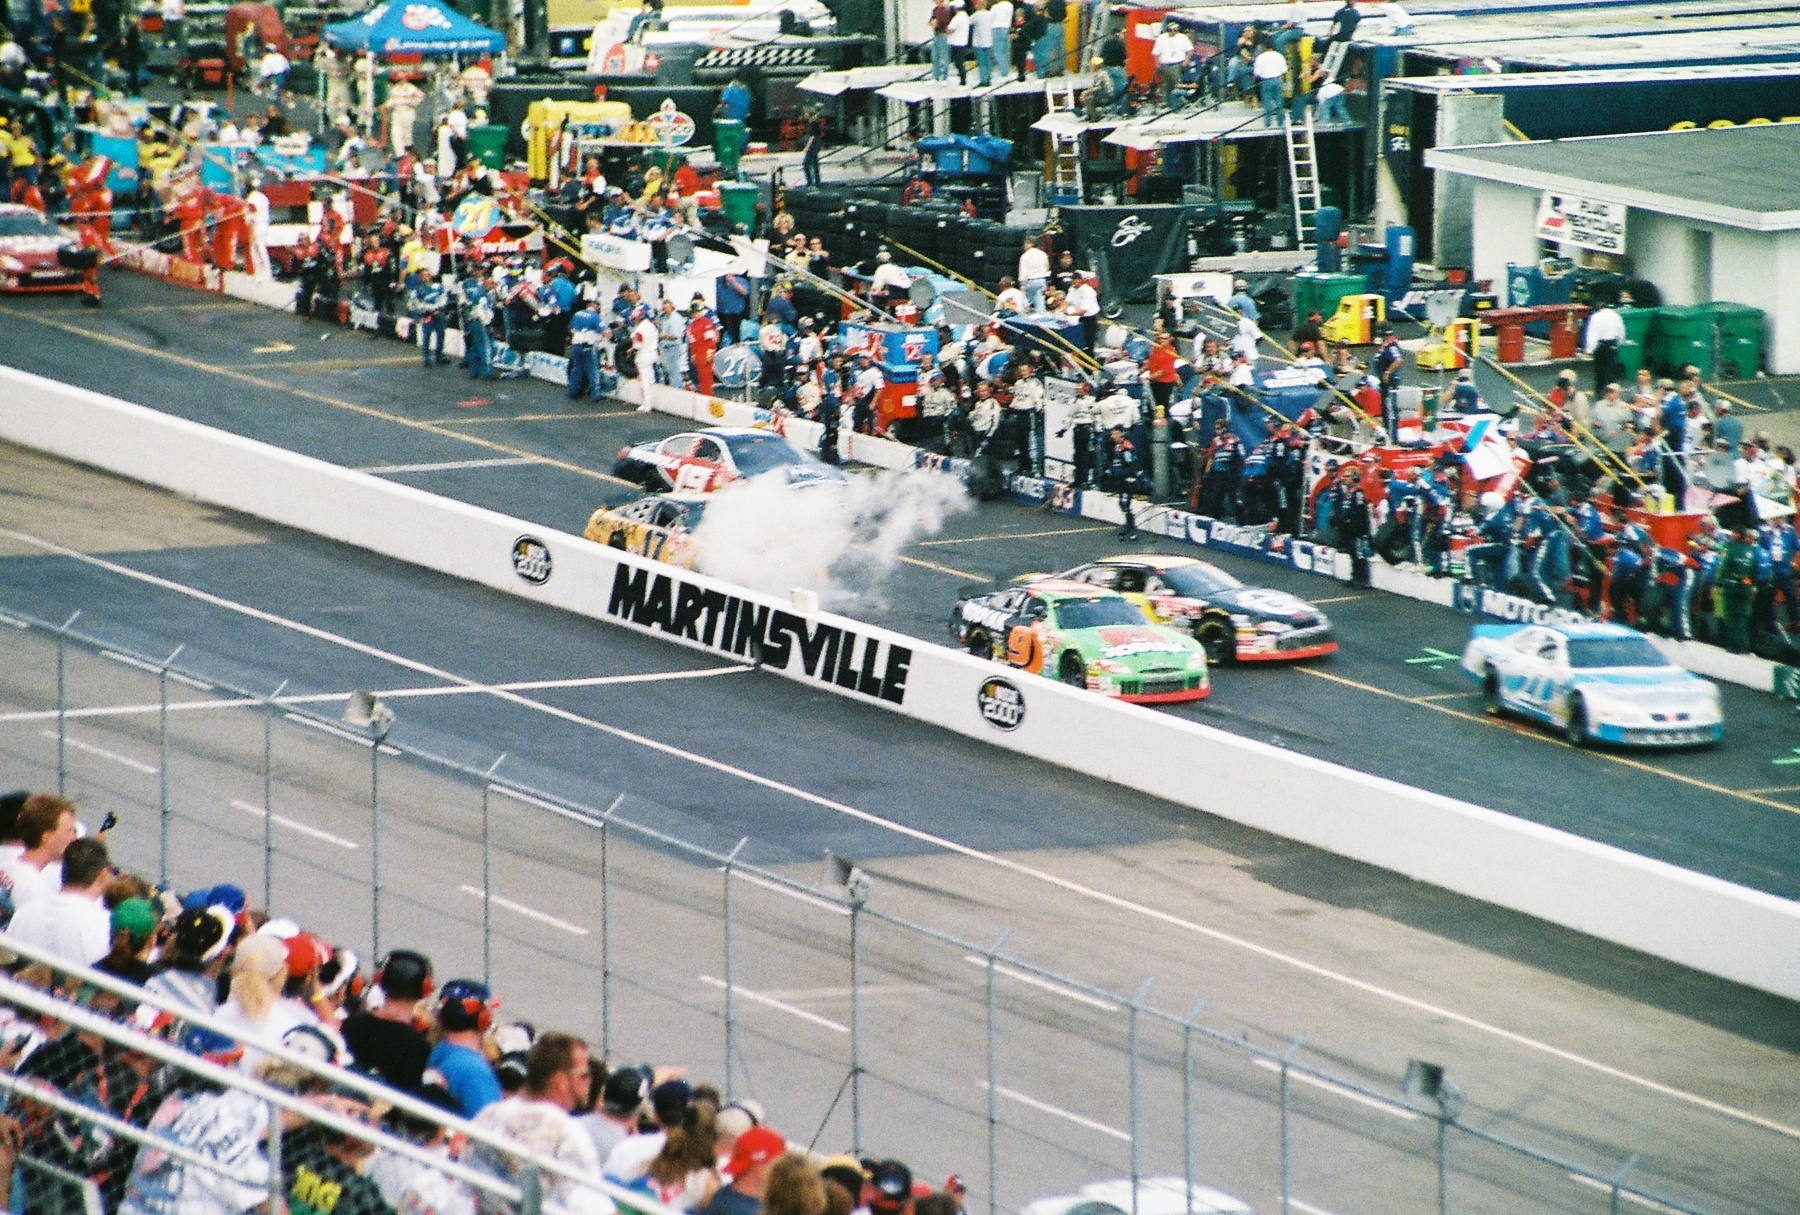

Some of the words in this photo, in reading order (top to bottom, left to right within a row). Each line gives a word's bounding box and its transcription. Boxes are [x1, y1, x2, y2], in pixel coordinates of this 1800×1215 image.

[1579, 200, 1609, 217] FLUID
[1565, 212, 1622, 235] RECYCLING
[1570, 228, 1617, 249] SERVICES
[642, 528, 669, 561] 17
[607, 562, 912, 705] MARTINSVILLE
[1007, 625, 1036, 669] 9
[983, 702, 1018, 725] 2000
